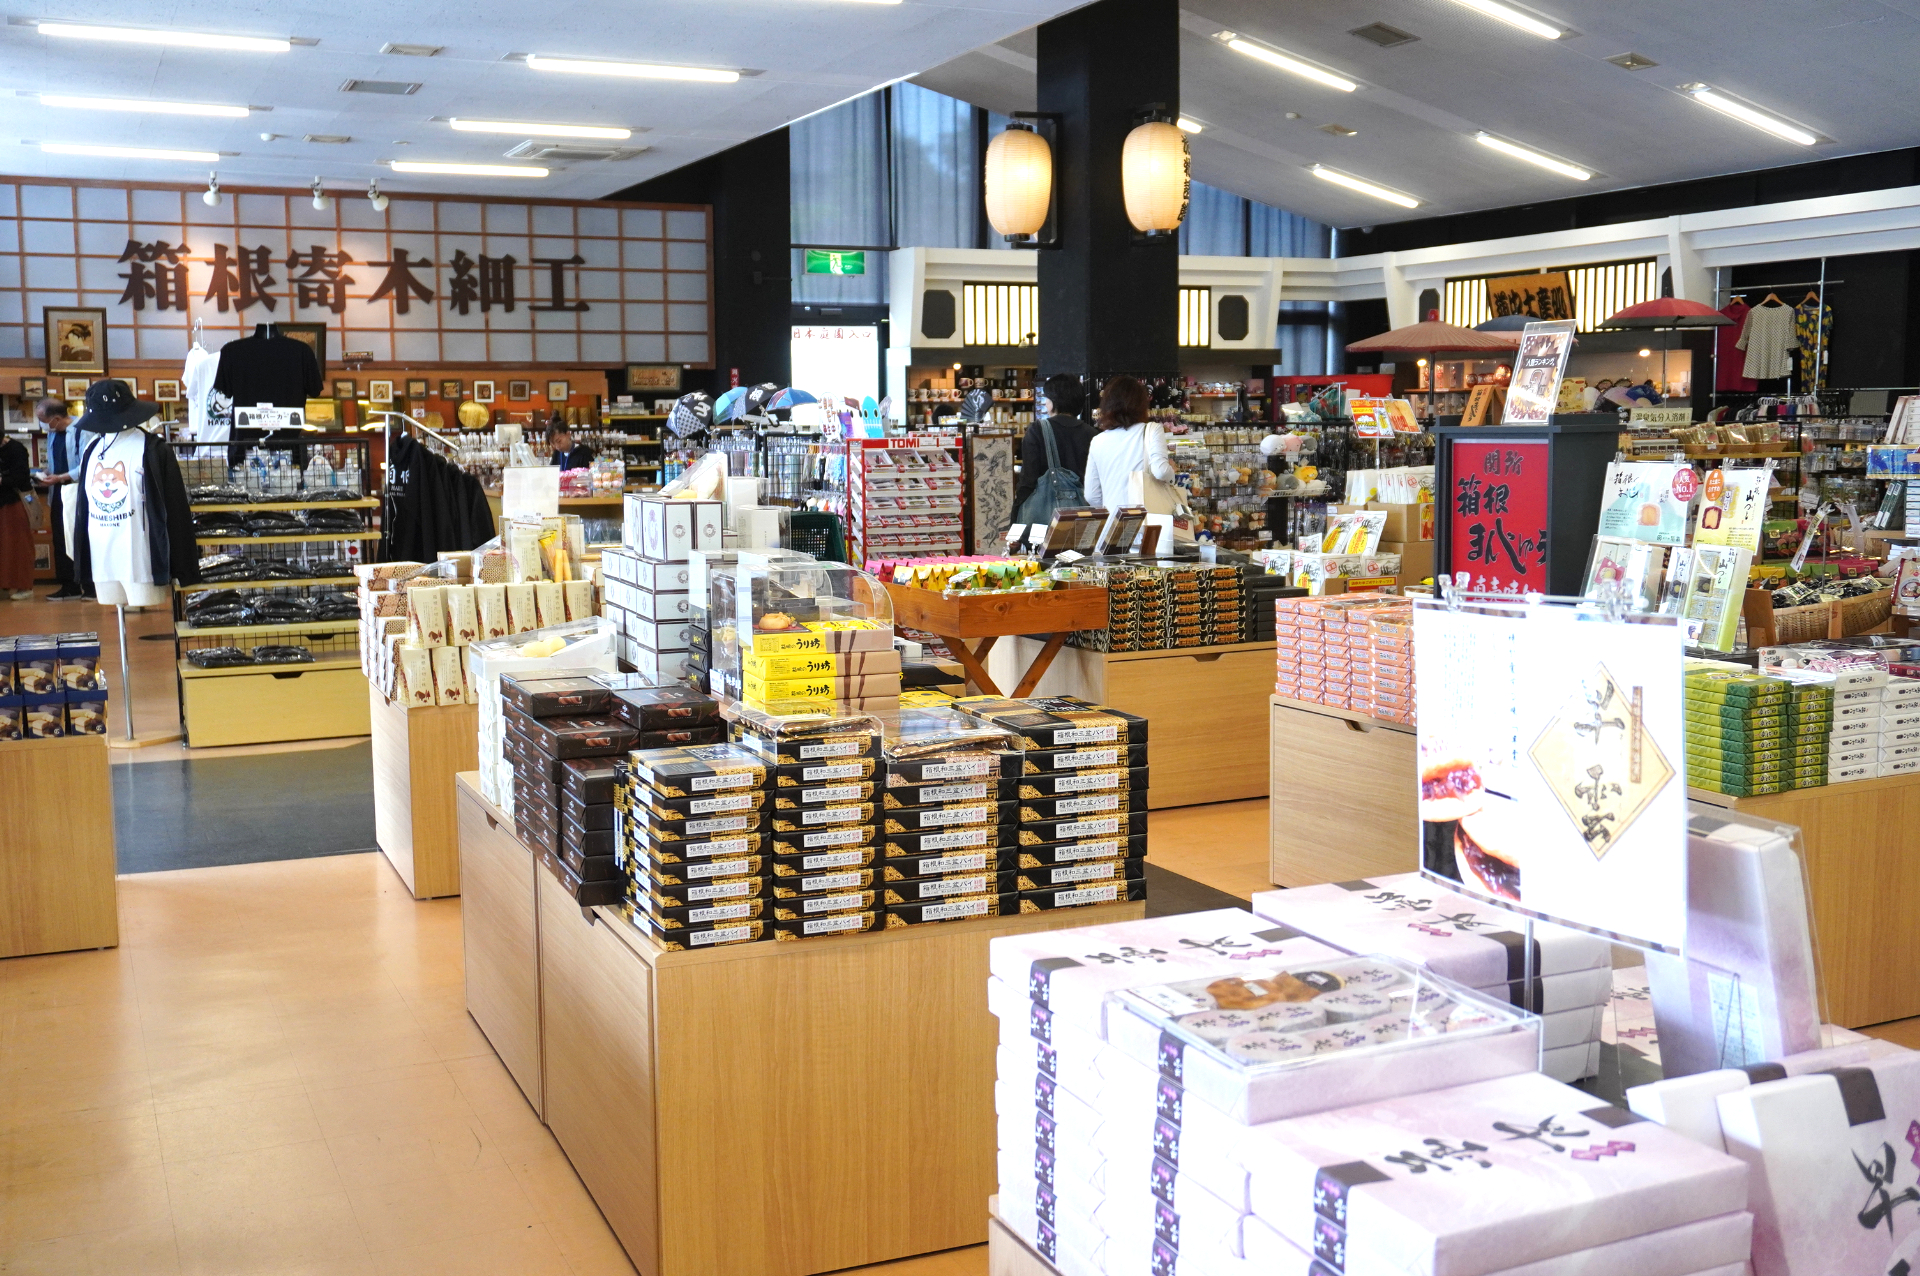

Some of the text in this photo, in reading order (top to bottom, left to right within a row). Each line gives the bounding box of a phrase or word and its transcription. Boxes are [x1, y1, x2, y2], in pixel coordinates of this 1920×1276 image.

[117, 239, 591, 316] 箱根寄木細工
[1635, 412, 1686, 422] 温泉気分入浴剤
[890, 438, 920, 448] TOMI
[1675, 483, 1693, 493] No.1
[1457, 473, 1510, 518] 箱根
[796, 638, 820, 650] うり坊
[807, 660, 831, 672] うり坊
[806, 684, 830, 696] うり坊
[1057, 729, 1106, 739] 箱根和三盆パイ
[1057, 752, 1106, 763] 箱根和三盆パイ
[925, 763, 977, 773] 箱根和三盆パイ
[1058, 776, 1107, 786] 箱根和三盆パイ
[923, 786, 974, 796] 箱根和三盆パイ
[923, 810, 974, 820] 箱根和三盆パイ
